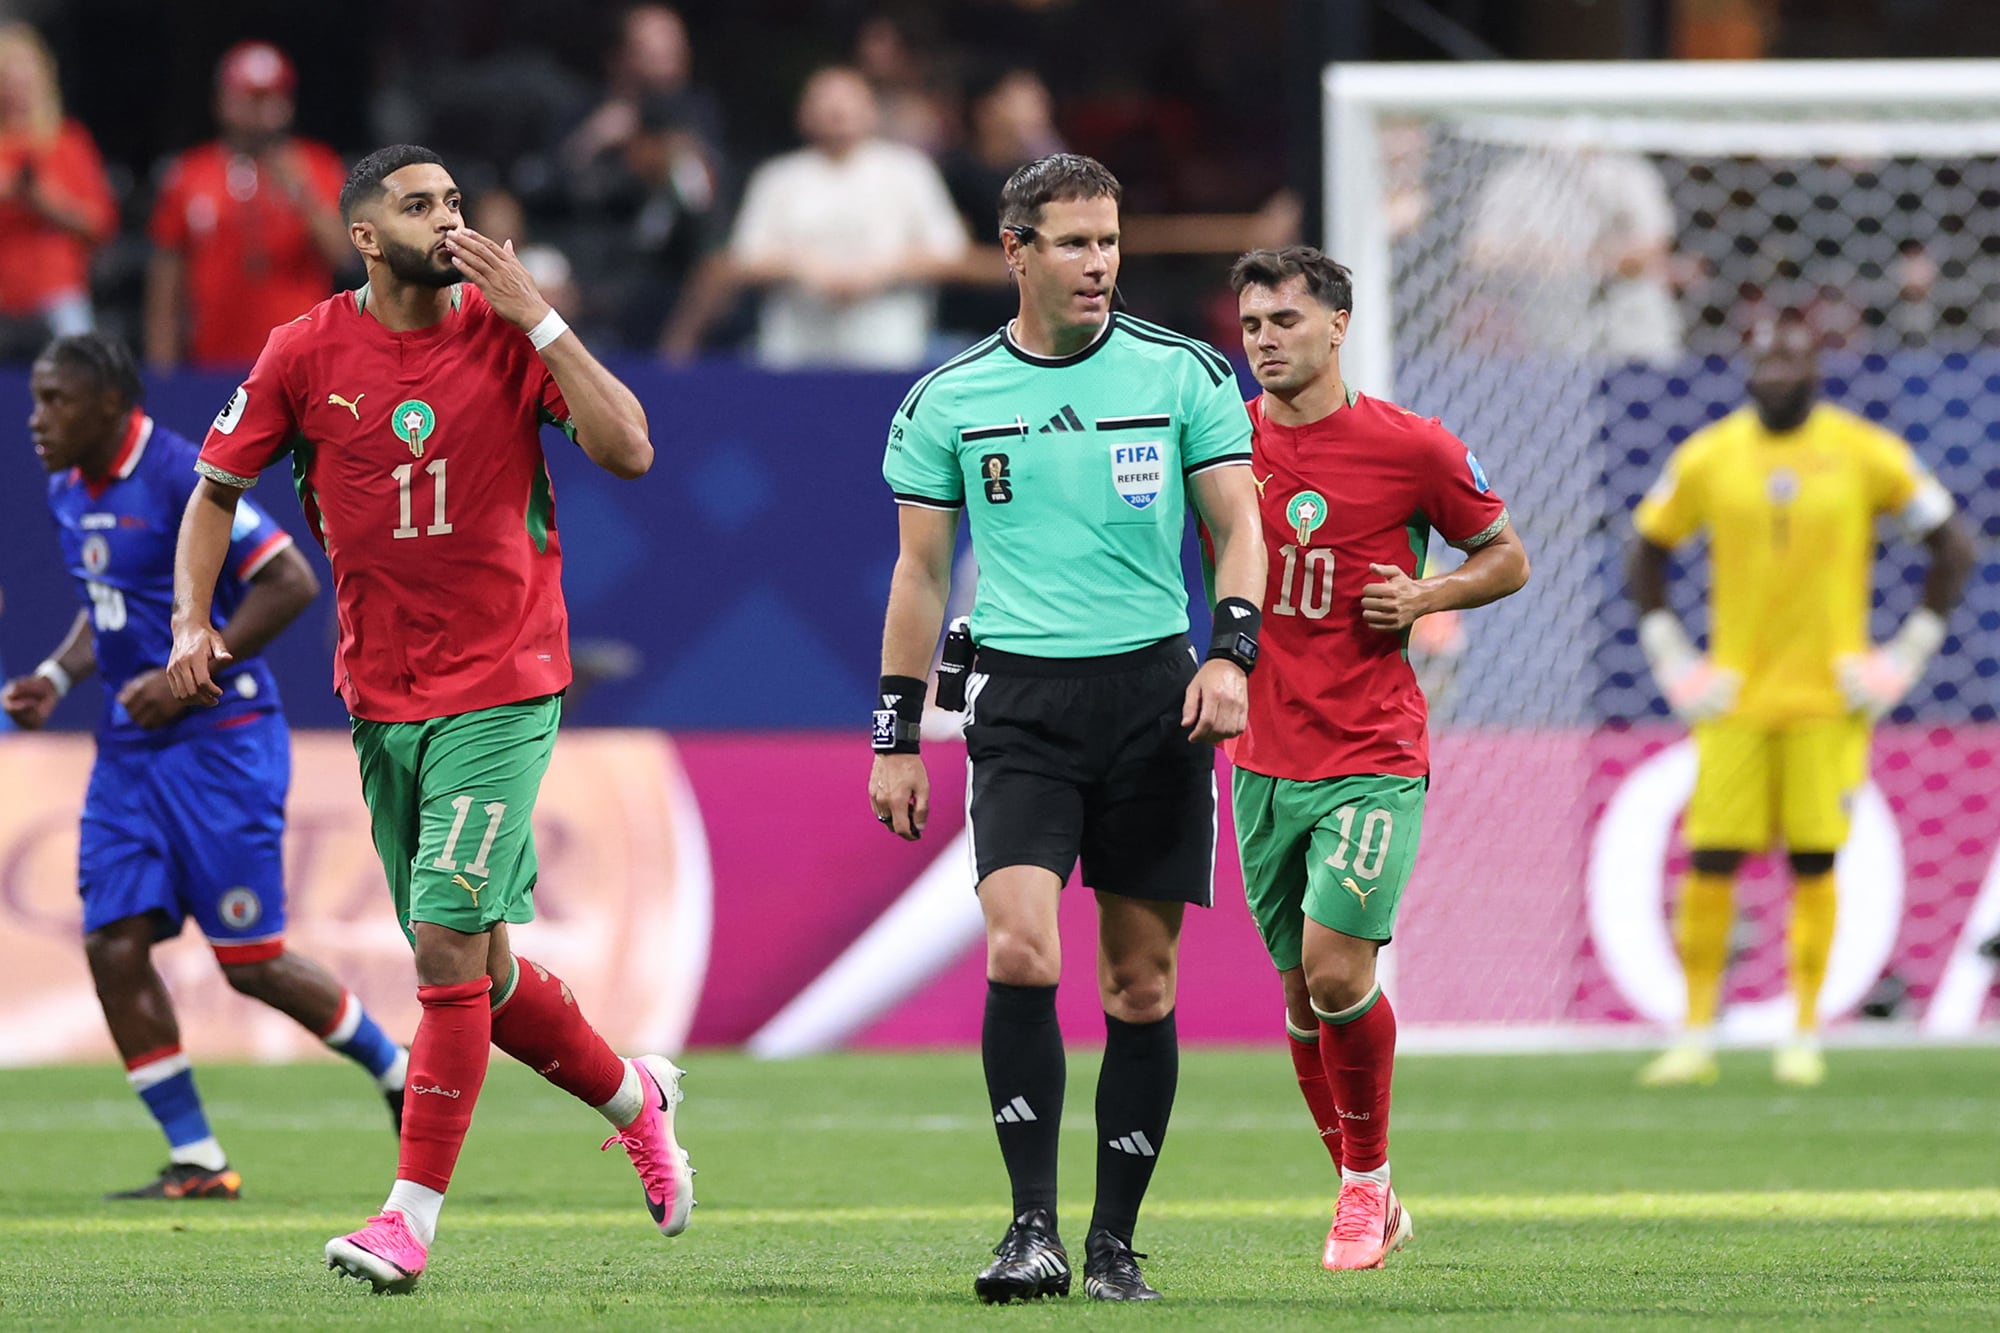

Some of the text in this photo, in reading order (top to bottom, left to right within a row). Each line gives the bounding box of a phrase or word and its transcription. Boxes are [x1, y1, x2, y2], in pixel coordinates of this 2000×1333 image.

[891, 423, 904, 442] FA
[1116, 446, 1159, 464] FIFA
[391, 458, 453, 539] 11
[1117, 472, 1160, 483] REFEREE
[1130, 495, 1151, 504] 2026
[1272, 543, 1336, 619] 10
[432, 794, 507, 879] 11
[1324, 806, 1394, 881] 10
